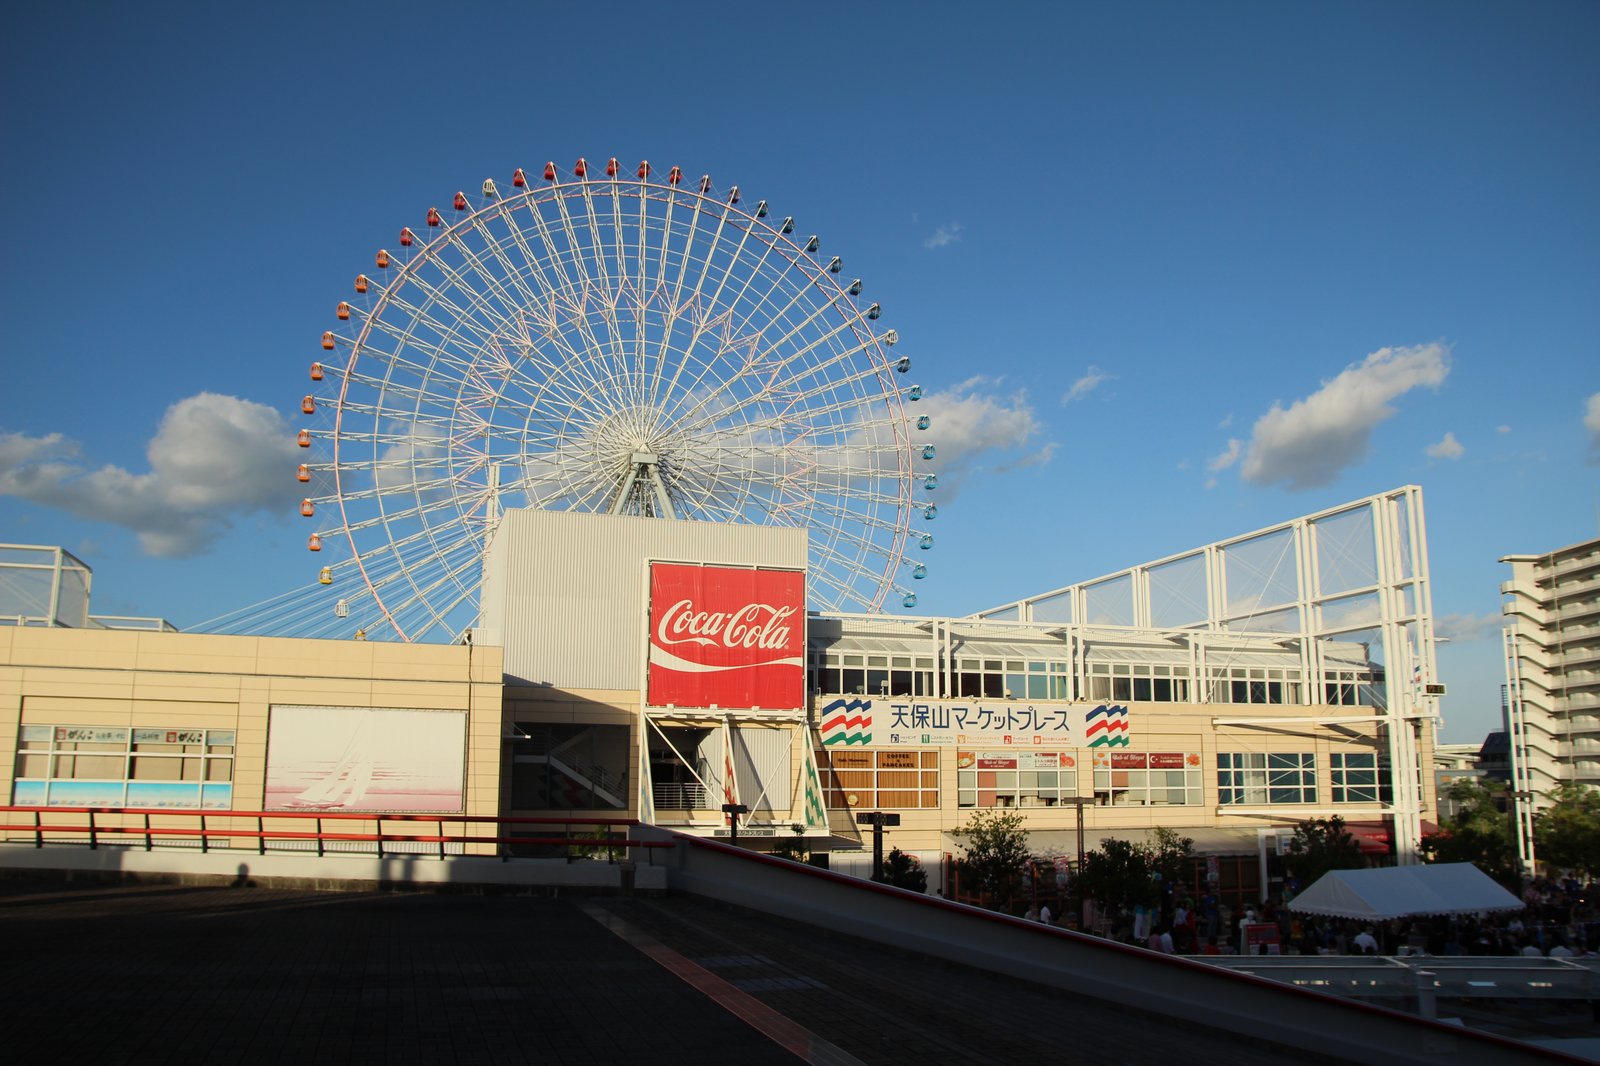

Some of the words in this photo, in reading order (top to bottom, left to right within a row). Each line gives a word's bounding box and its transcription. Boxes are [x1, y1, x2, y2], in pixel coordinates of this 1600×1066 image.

[658, 599, 798, 650] Coca-Cola
[890, 704, 1070, 732] 天保山マーケットプレース
[178, 732, 203, 743] がんこ
